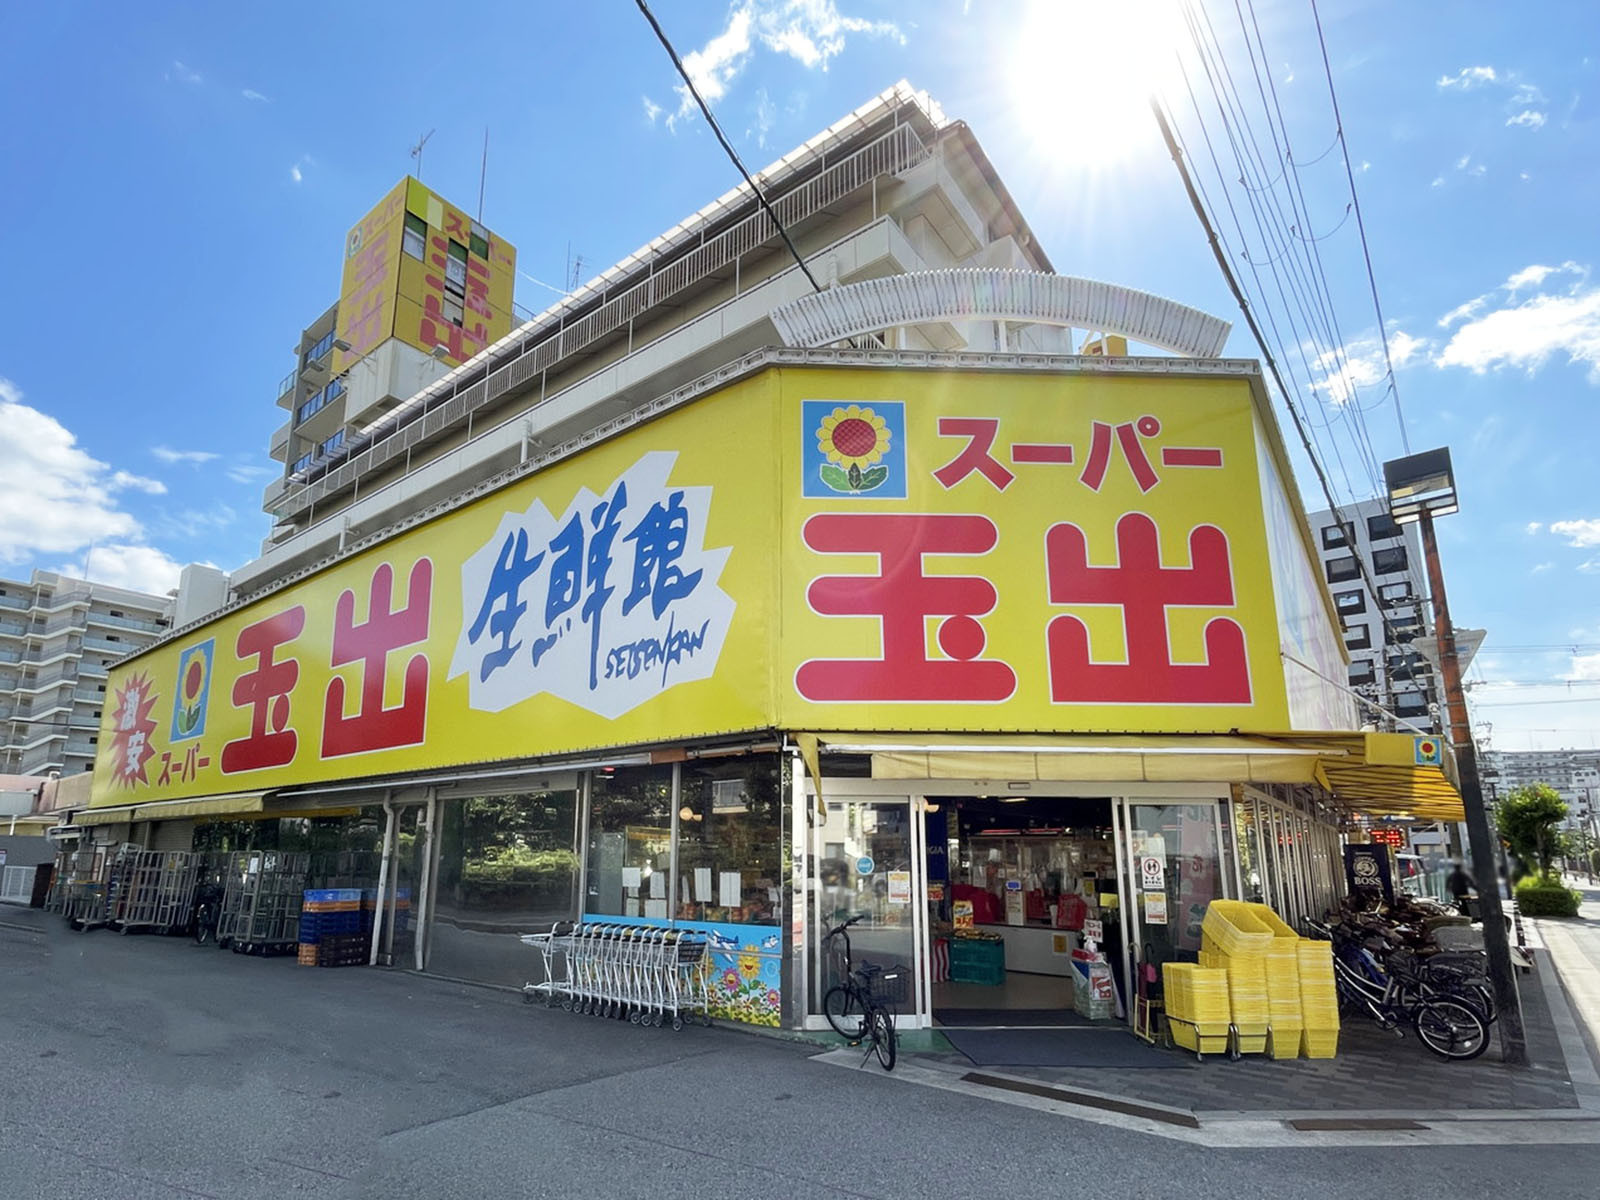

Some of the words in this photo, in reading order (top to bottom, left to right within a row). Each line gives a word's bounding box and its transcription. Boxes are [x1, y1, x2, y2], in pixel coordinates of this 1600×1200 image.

[931, 415, 1224, 494] スーパー
[468, 480, 704, 691] 生鮮館
[794, 511, 1255, 706] 玉出
[220, 556, 434, 775] 玉出
[158, 742, 211, 787] スーパー
[1354, 876, 1382, 886] BOSS
